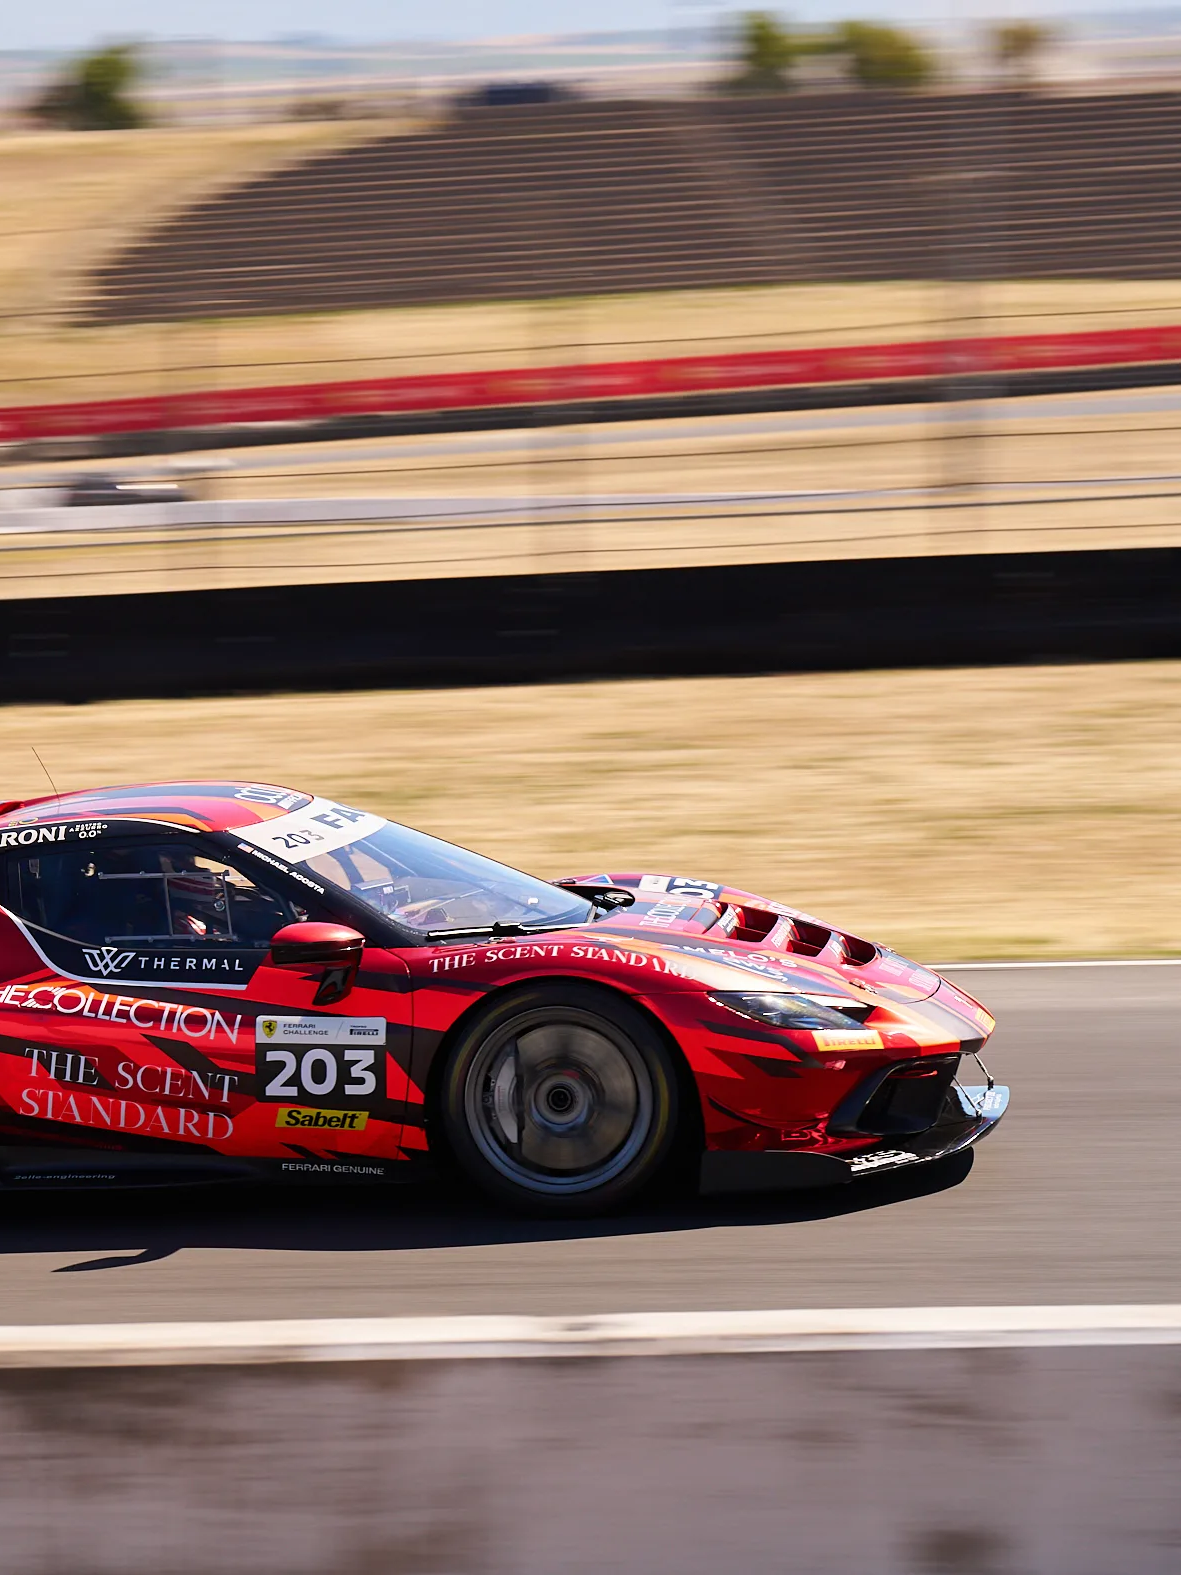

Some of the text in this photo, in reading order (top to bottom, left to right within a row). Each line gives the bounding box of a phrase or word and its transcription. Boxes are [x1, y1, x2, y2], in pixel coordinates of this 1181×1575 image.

[272, 829, 325, 849] 203
[251, 849, 325, 895] MICHAEL ACOSTA
[138, 957, 244, 971] THERMAL
[429, 945, 697, 980] THE SCENT STANDARD
[20, 986, 242, 1044] COLLECTION
[349, 1028, 379, 1036] PIRELLI
[822, 1034, 877, 1047] PIRELLI
[24, 1047, 239, 1104] THE SCENT
[265, 1048, 377, 1097] 203
[19, 1088, 234, 1140] STANDARD
[285, 1109, 360, 1129] Sabelt
[282, 1162, 385, 1175] FERRARI GENUINE
